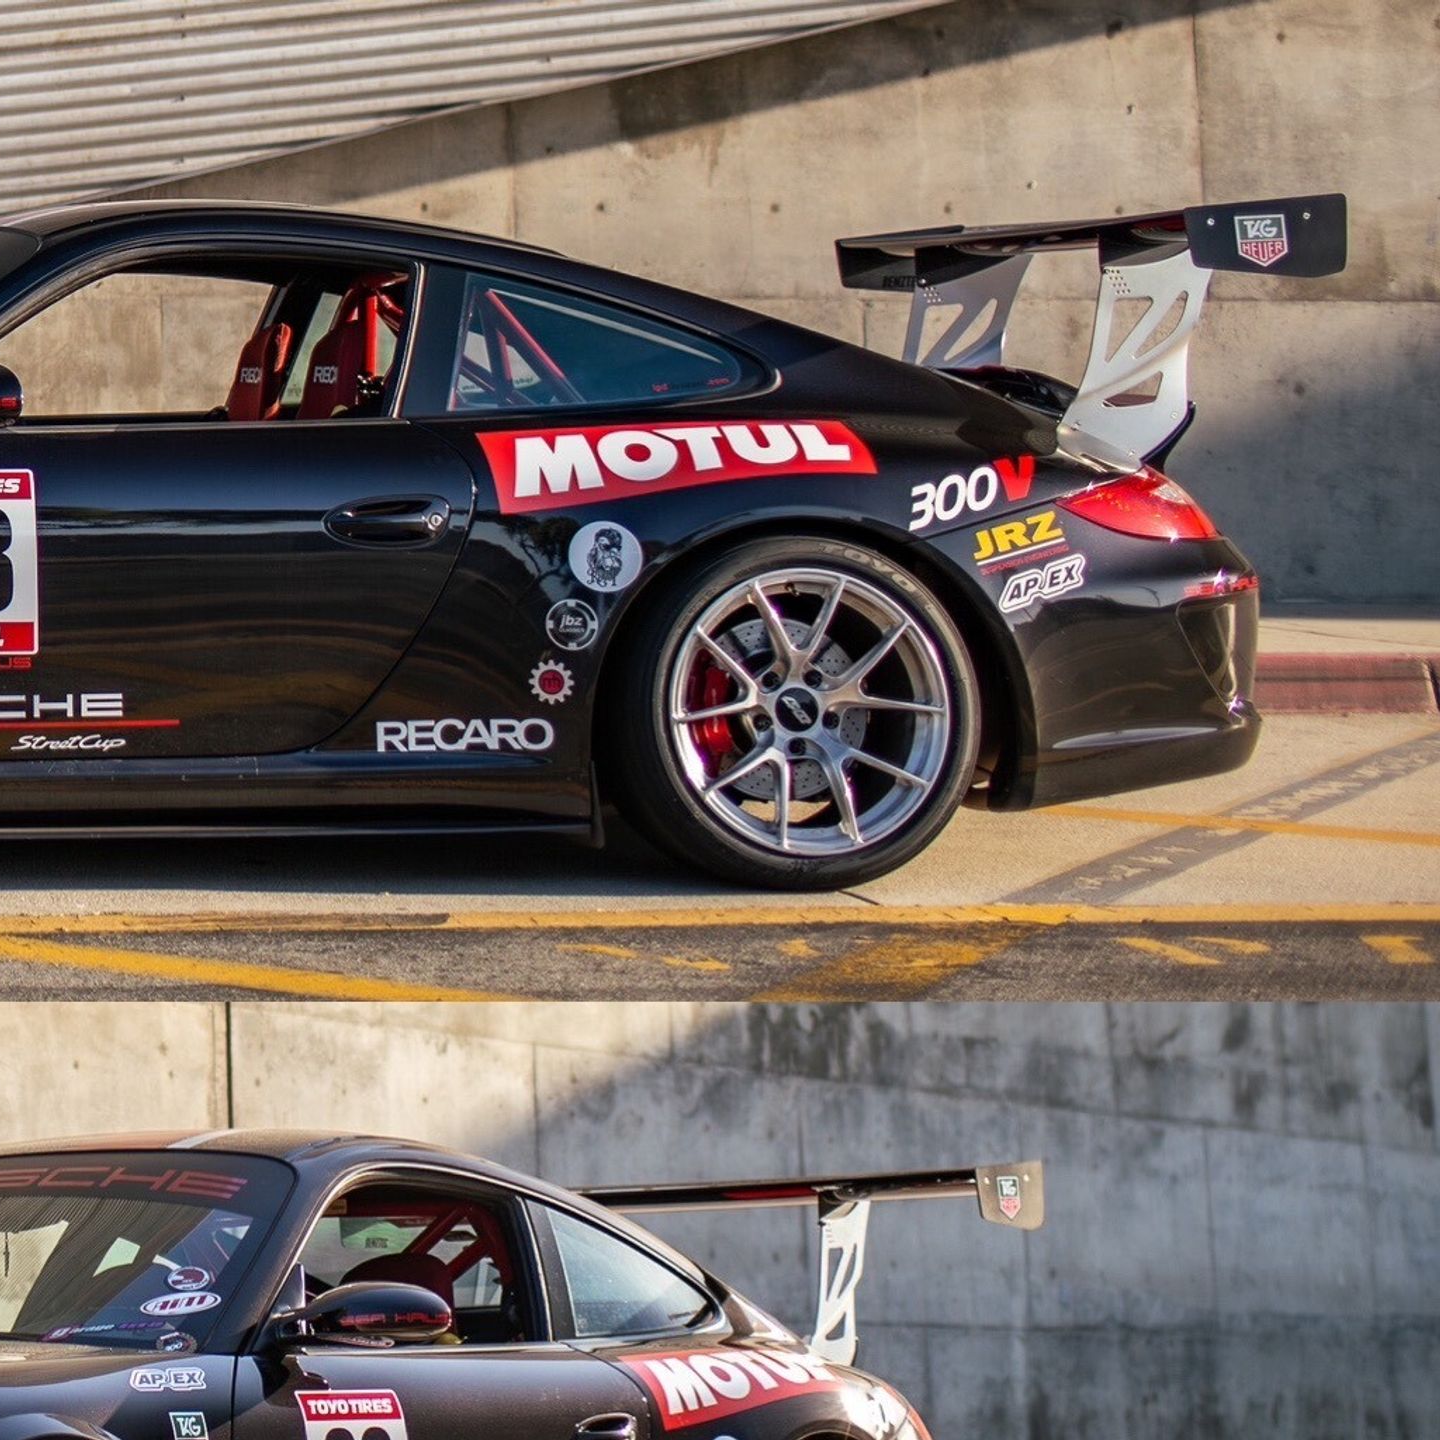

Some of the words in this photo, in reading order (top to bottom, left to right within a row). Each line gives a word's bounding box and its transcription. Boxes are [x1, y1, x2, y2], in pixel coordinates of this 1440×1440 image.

[1244, 219, 1278, 237] TAG
[1241, 239, 1284, 258] HEUER
[514, 422, 852, 499] MOTUL
[909, 455, 1035, 531] 300V
[974, 511, 1063, 560] JRZ
[560, 614, 583, 629] jbz
[376, 718, 555, 752] RECARO
[307, 1400, 349, 1415] TOYO
[350, 1399, 394, 1414] TIRES
[179, 1415, 203, 1436] TAG
